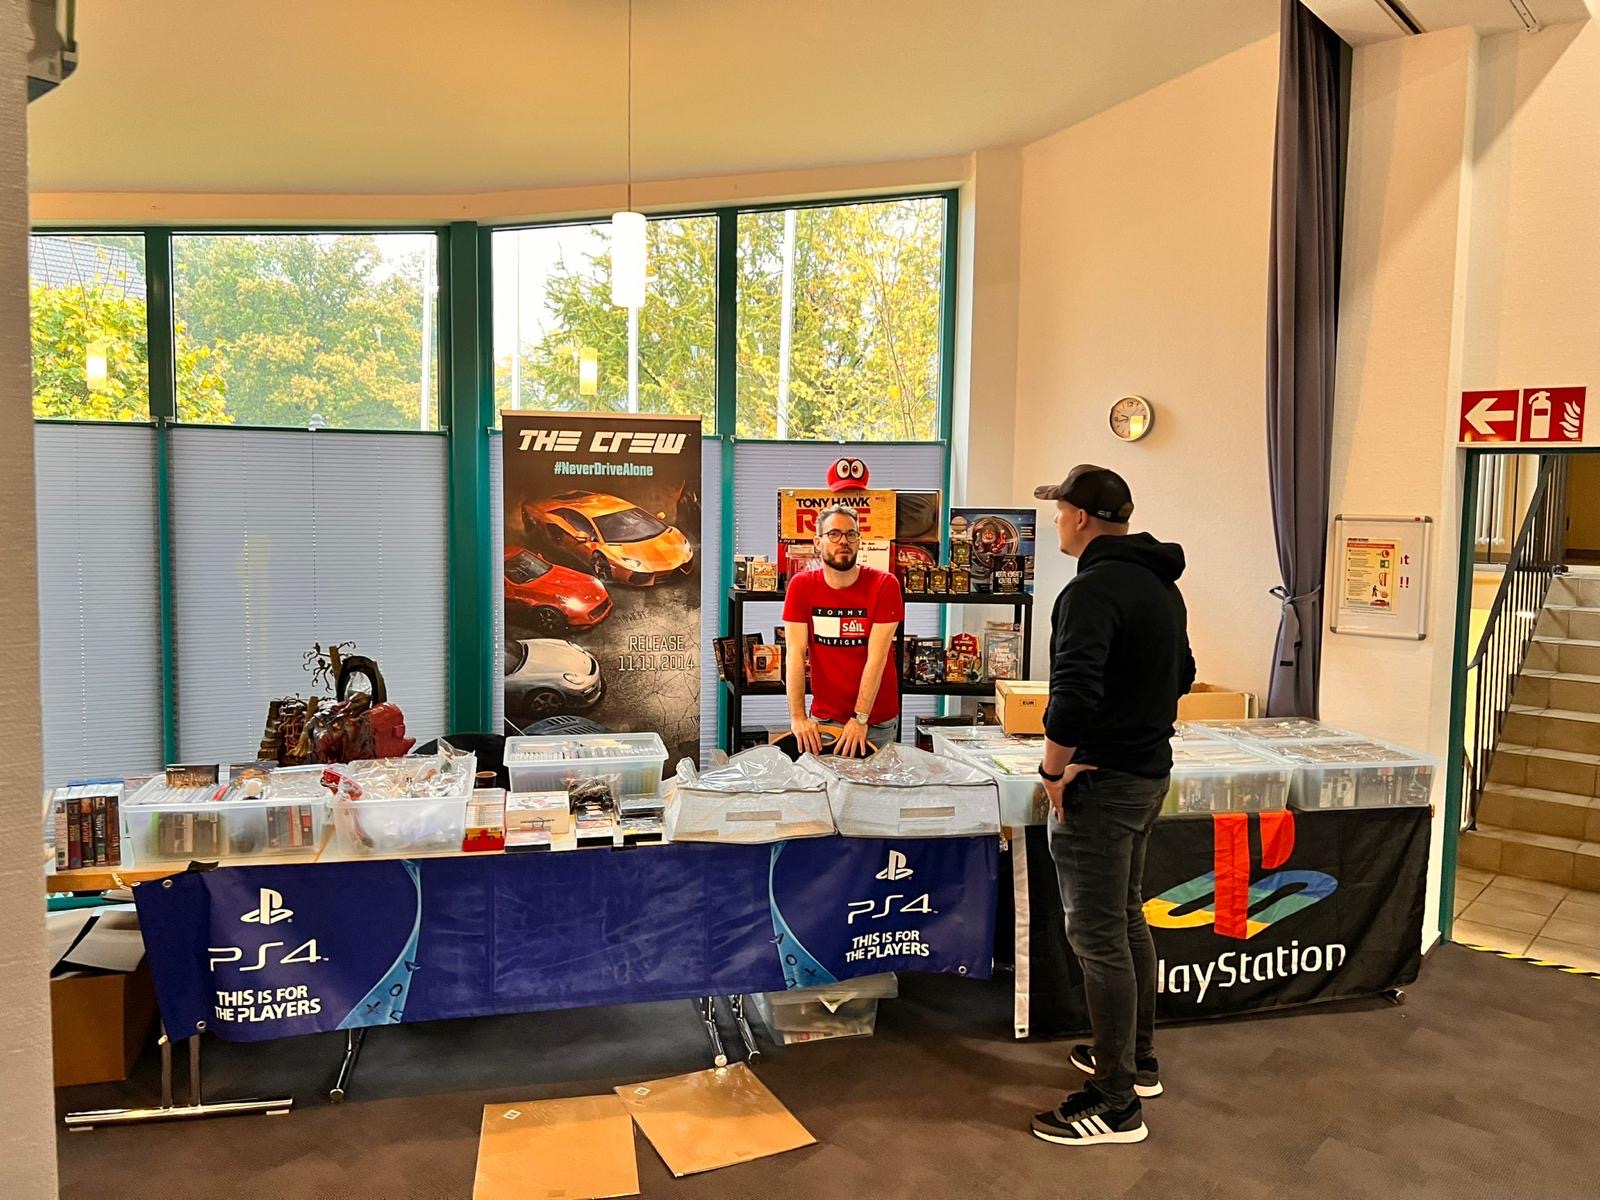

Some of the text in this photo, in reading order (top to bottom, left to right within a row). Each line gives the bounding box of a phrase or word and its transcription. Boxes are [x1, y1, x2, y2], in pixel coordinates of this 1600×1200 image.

[518, 430, 582, 451] THE
[554, 461, 653, 476] #NeverDriveAlone
[796, 497, 831, 508] TONY
[831, 497, 870, 507] HAWK
[796, 508, 871, 534] RE
[817, 608, 863, 616] TOMMY
[629, 635, 684, 651] RELEASE
[818, 637, 863, 646] HILFIGER
[619, 655, 694, 671] 11.11.2014
[848, 893, 933, 924] PS4
[852, 930, 920, 949] THIS IS FOR
[208, 938, 322, 972] PS4
[845, 942, 930, 963] THE PLAYERS
[1157, 940, 1347, 1003] layStation
[216, 985, 308, 1006] THIS IS FOR
[215, 998, 321, 1023] THE PLAYERS
